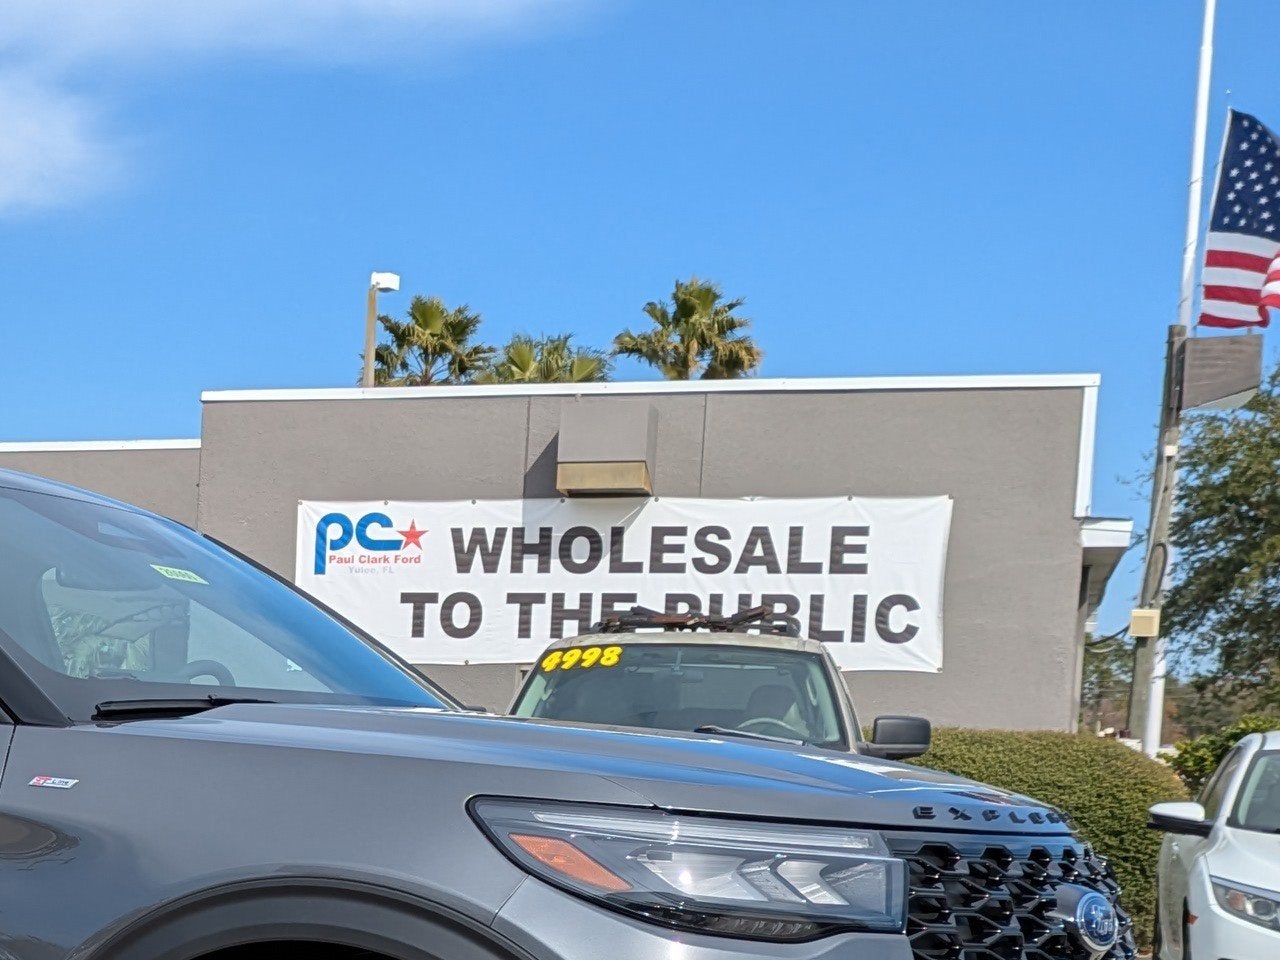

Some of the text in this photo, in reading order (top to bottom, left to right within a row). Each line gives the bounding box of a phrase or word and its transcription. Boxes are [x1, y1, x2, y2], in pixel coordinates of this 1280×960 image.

[328, 554, 421, 564] Paul Clark Ford
[450, 524, 871, 576] WHOLESALE
[382, 565, 395, 574] FL
[400, 591, 483, 639] TO
[506, 592, 638, 639] THE
